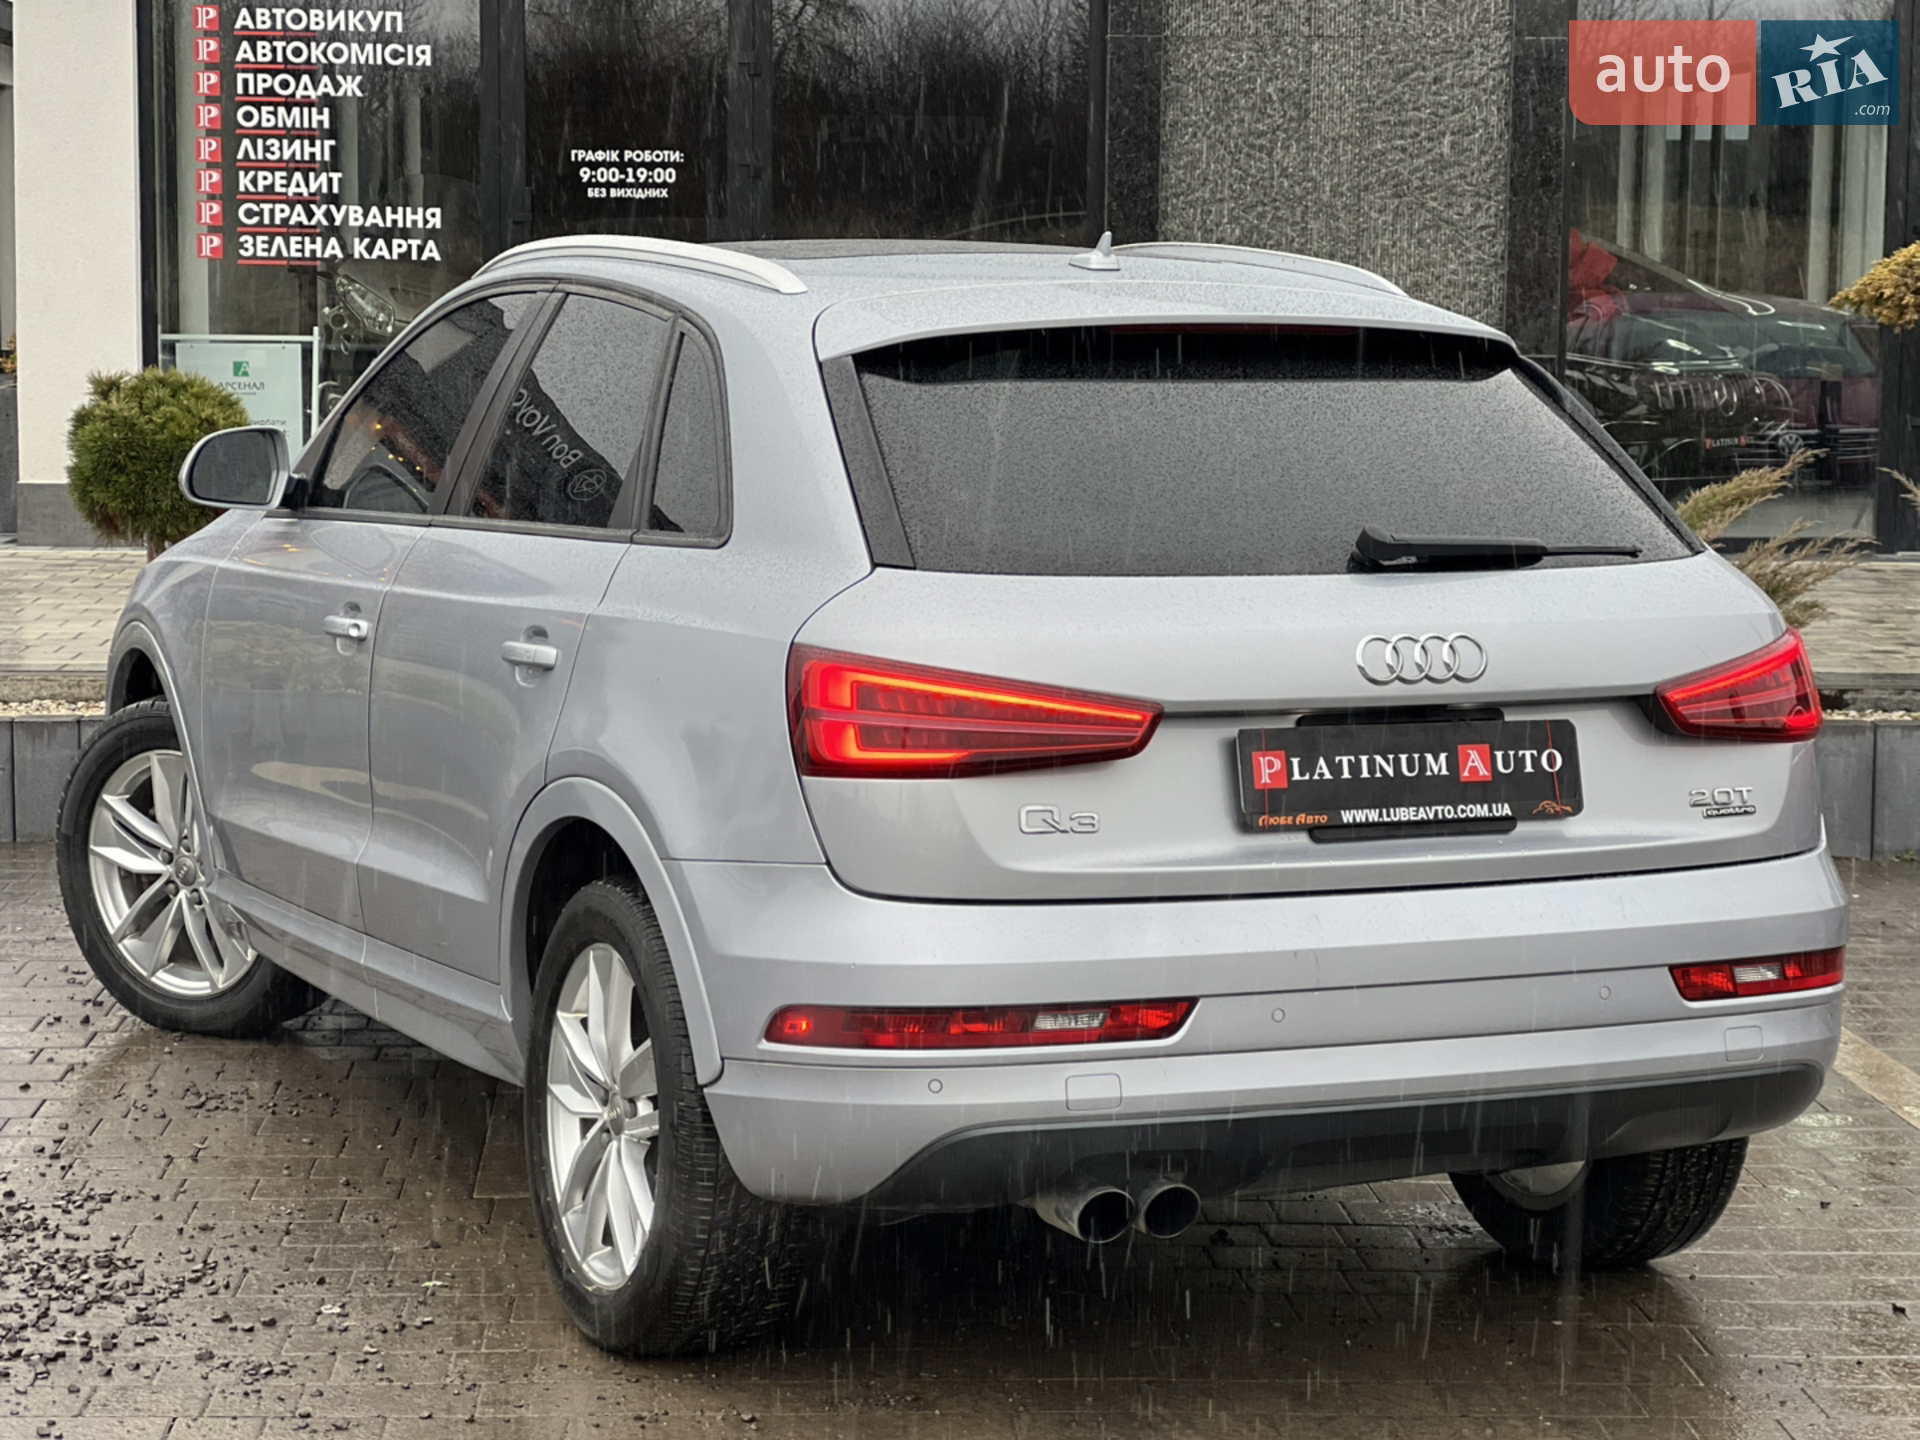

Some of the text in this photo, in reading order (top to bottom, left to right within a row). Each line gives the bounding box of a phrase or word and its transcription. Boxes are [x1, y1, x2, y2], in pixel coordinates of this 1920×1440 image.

[234, 7, 403, 32] АВТОВИКУП
[235, 40, 432, 67] АВТОКОМІСІЯ
[236, 73, 364, 100] ПРОДАЖ
[236, 106, 330, 129] ОБМІН
[236, 138, 336, 161] ЛІЗИНГ
[570, 149, 685, 163] ГРАФІК РОБОТИ:
[238, 170, 343, 197] КРЕДИТ
[579, 167, 676, 183] 9:00-19:00
[587, 187, 669, 199] БЕЗ ВИХІДНИХ
[238, 203, 442, 229] СТРАХУВАННЯ
[238, 235, 442, 261] ЗЕЛЕНА КАРТА
[1259, 748, 1564, 785] PLATINUM AUTO
[1019, 804, 1099, 834] Q3
[1341, 802, 1513, 824] WWW.LUBEAVTO.COM.UA
